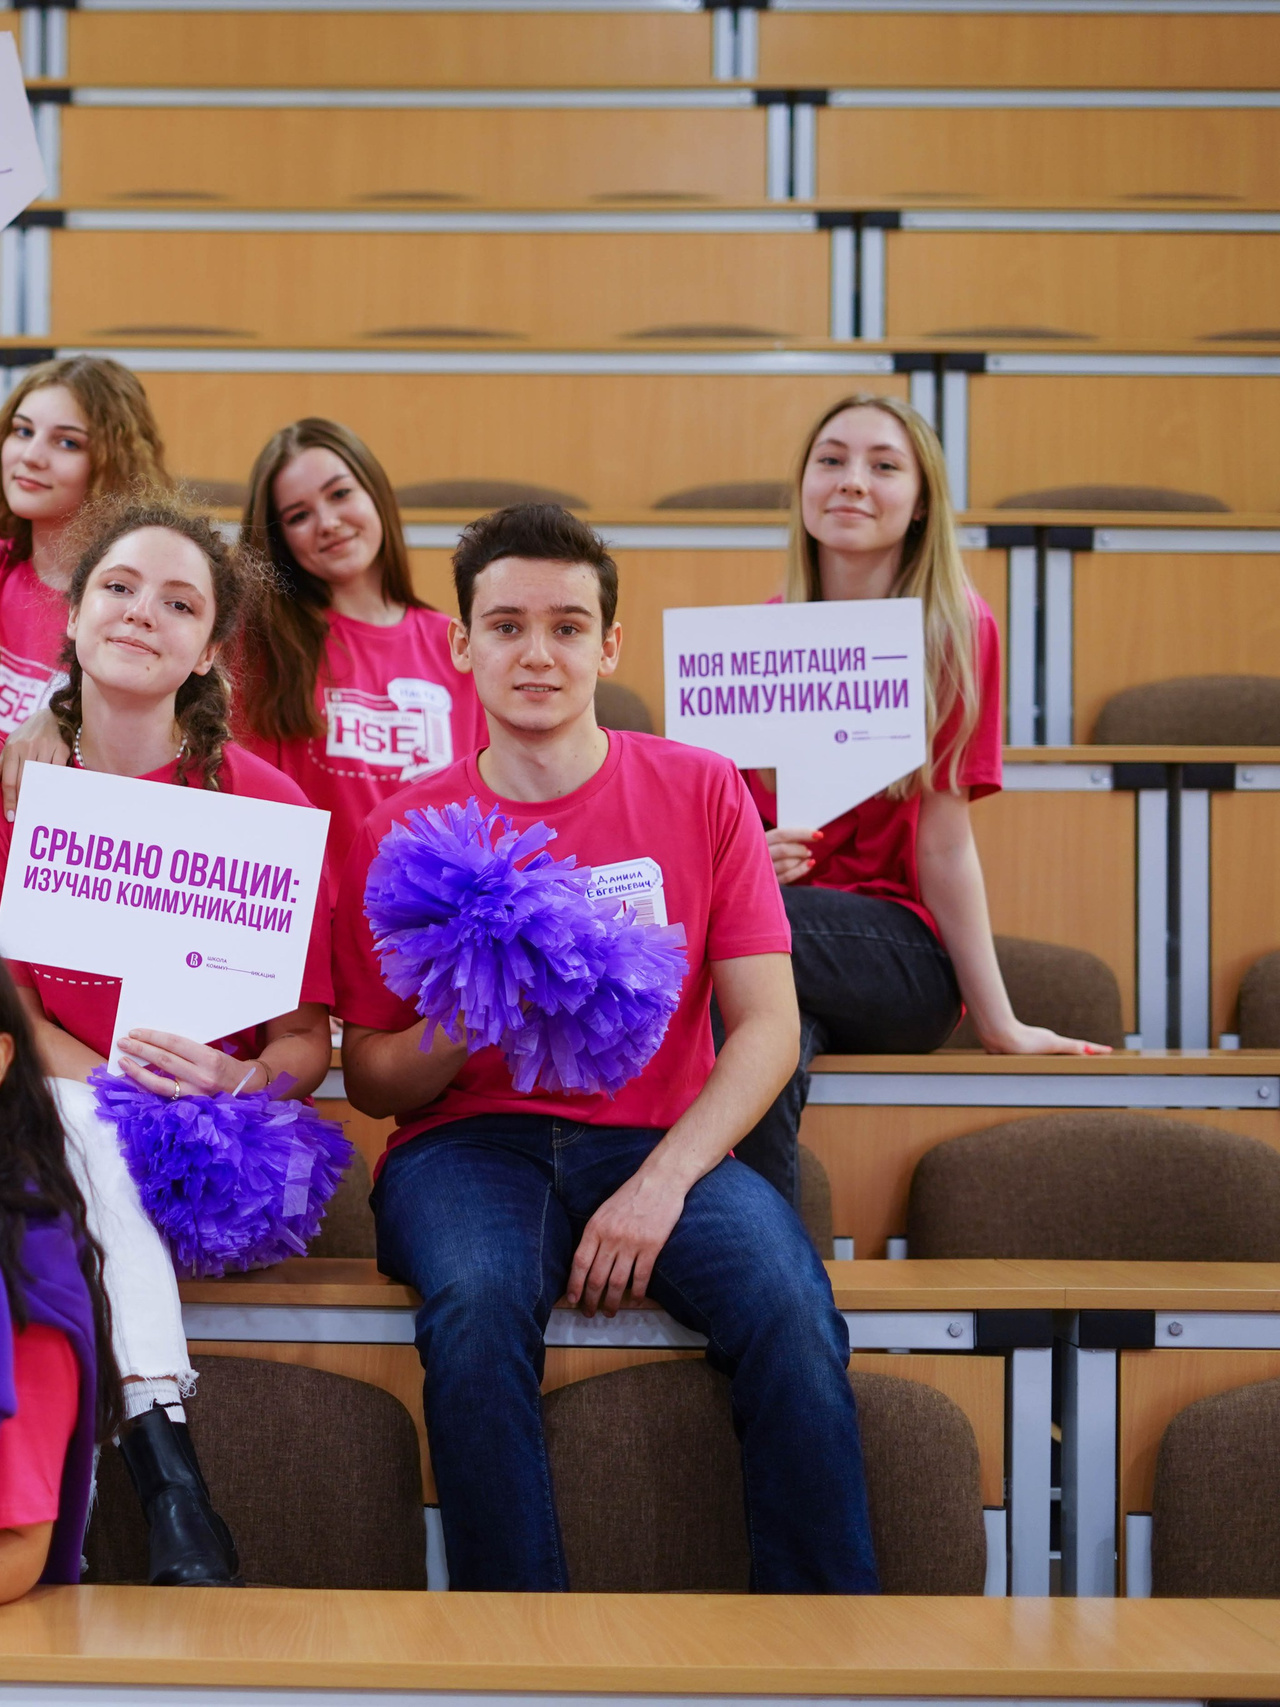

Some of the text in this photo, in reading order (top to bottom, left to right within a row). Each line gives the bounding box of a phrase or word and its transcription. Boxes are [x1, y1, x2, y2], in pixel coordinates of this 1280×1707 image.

[678, 653, 724, 678] МОЯ
[730, 647, 866, 677] МЕДИТАЦИЯ
[680, 679, 909, 717] КОММУНИКАЦИИ
[334, 716, 419, 754] HSE
[29, 825, 300, 904] СРЫВАЮ ОВАЦИИ:
[23, 865, 293, 934] ИЗУЧАЮ КОММУНИКАЦИИ
